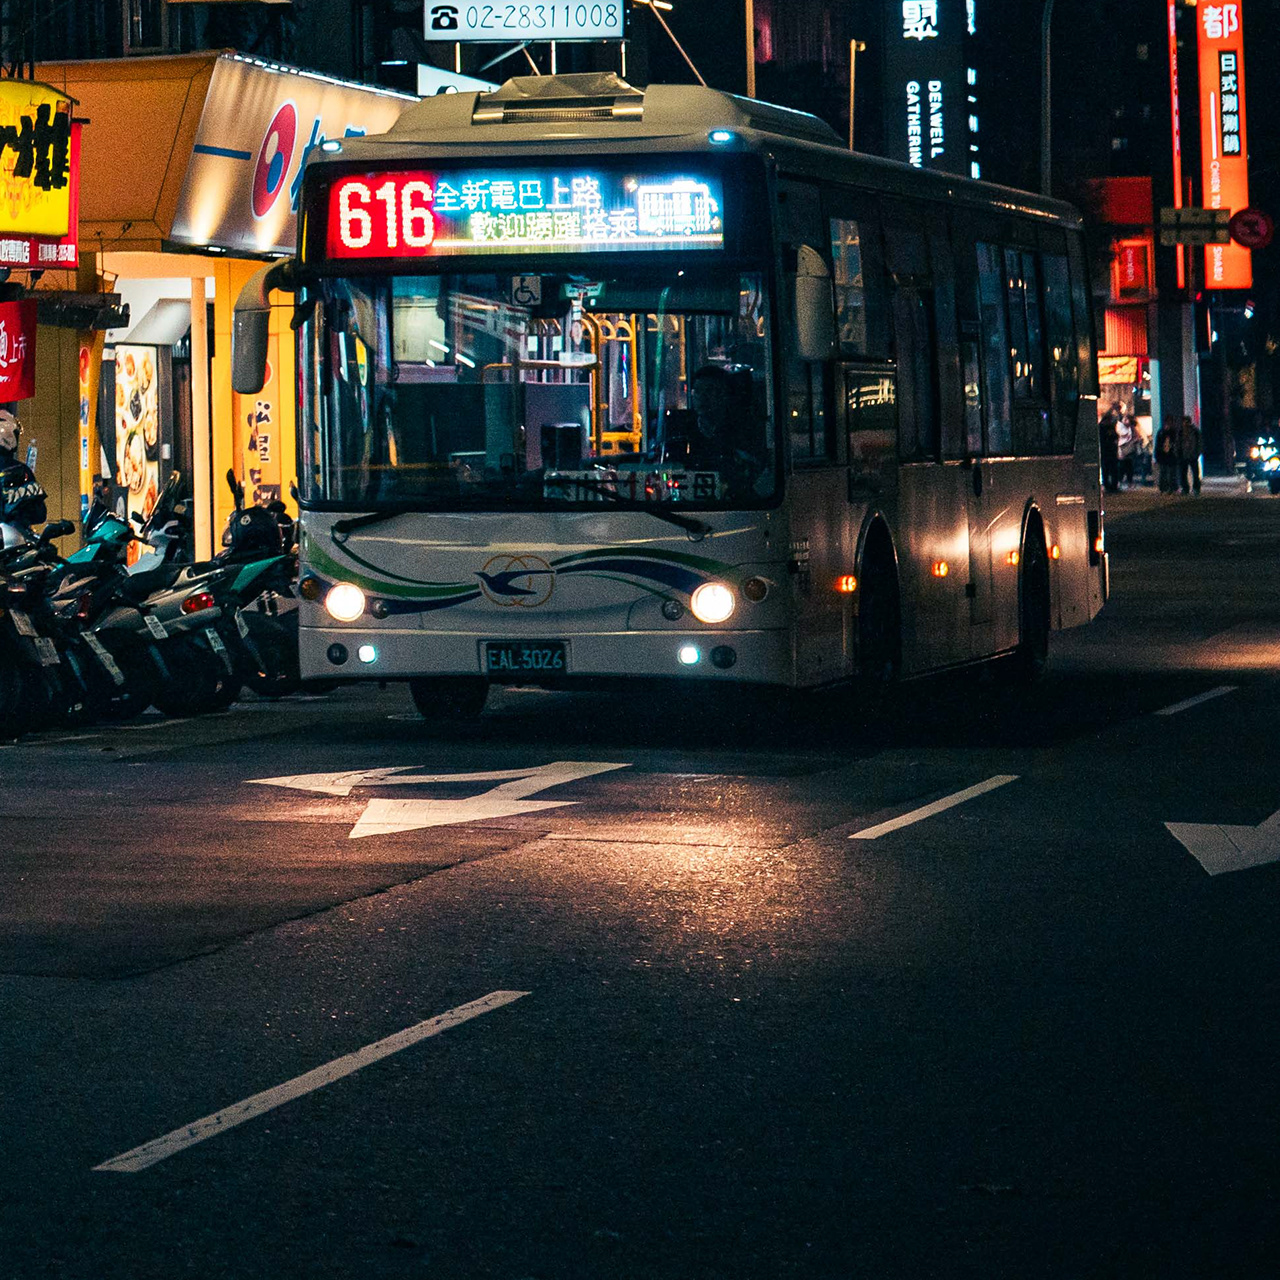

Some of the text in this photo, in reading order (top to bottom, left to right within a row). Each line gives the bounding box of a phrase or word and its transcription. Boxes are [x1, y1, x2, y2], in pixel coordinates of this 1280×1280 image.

[465, 4, 618, 28] 02-28311008
[906, 81, 922, 168] GATHERIN
[432, 176, 603, 212] 全新電巴上路
[339, 181, 435, 249] 616
[9, 333, 27, 363] 上市
[488, 649, 563, 670] EAL-3026
